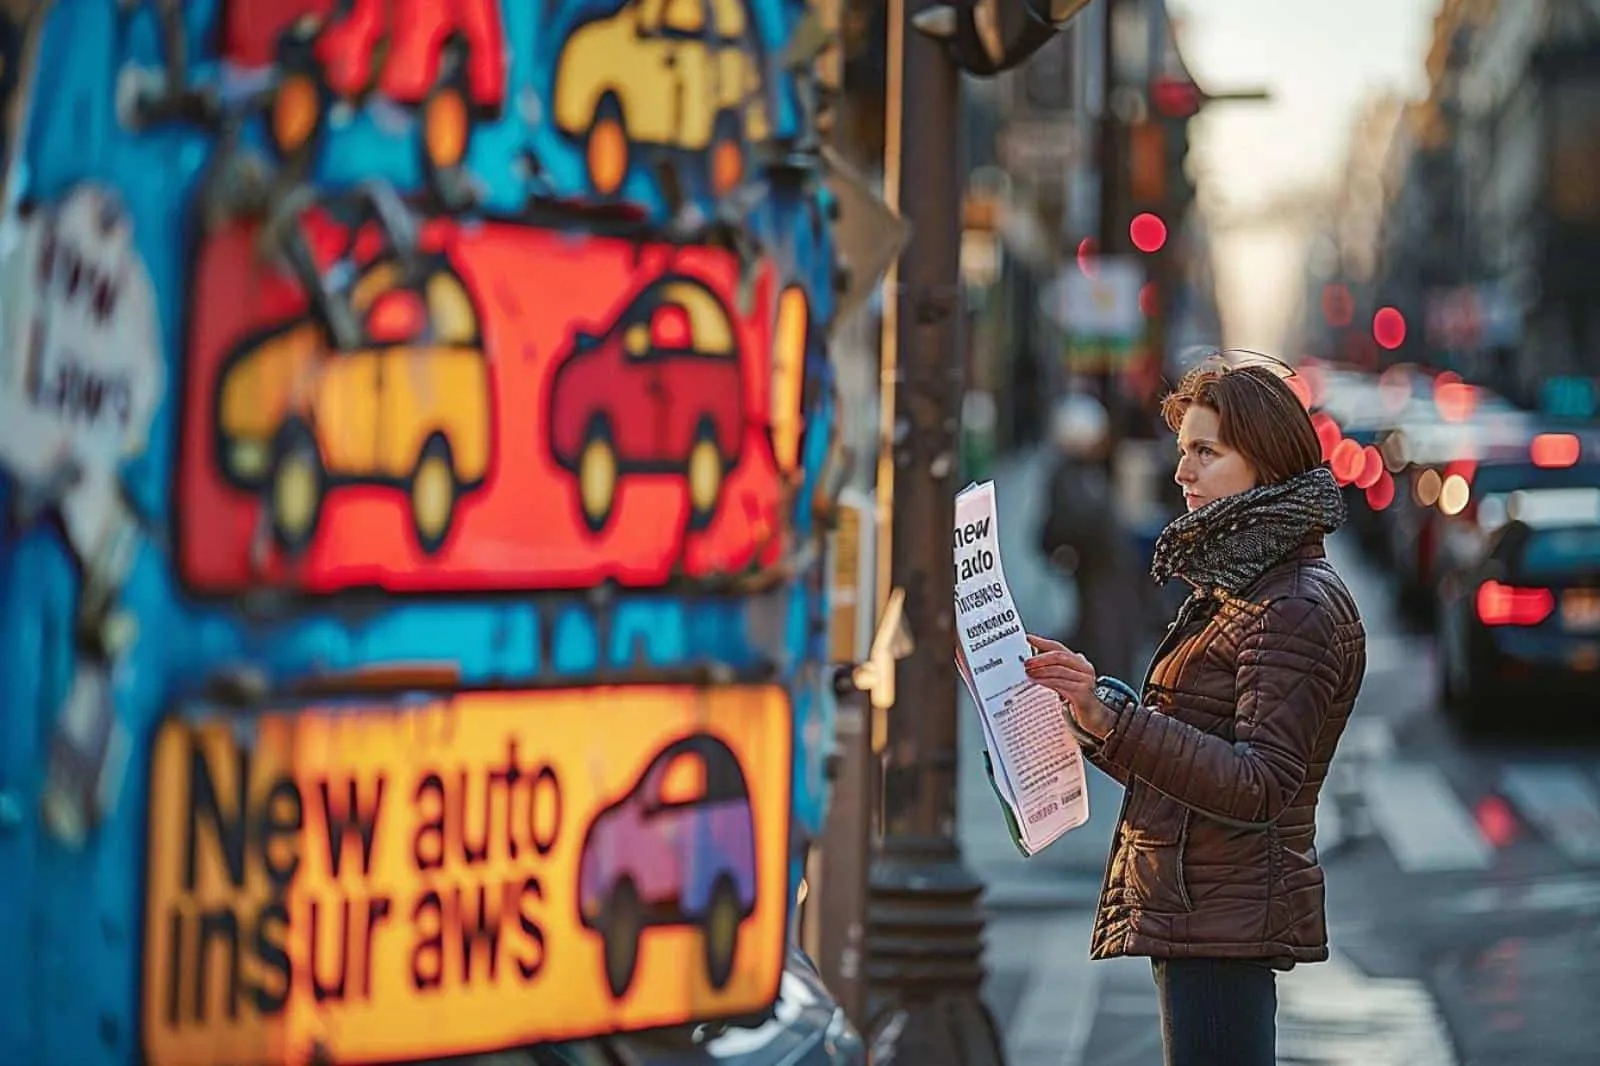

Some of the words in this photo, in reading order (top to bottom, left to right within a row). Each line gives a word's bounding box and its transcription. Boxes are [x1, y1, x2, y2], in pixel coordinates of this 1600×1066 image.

[953, 516, 990, 548] new
[183, 728, 385, 892] New
[412, 738, 562, 872] auto
[411, 876, 547, 990] aws
